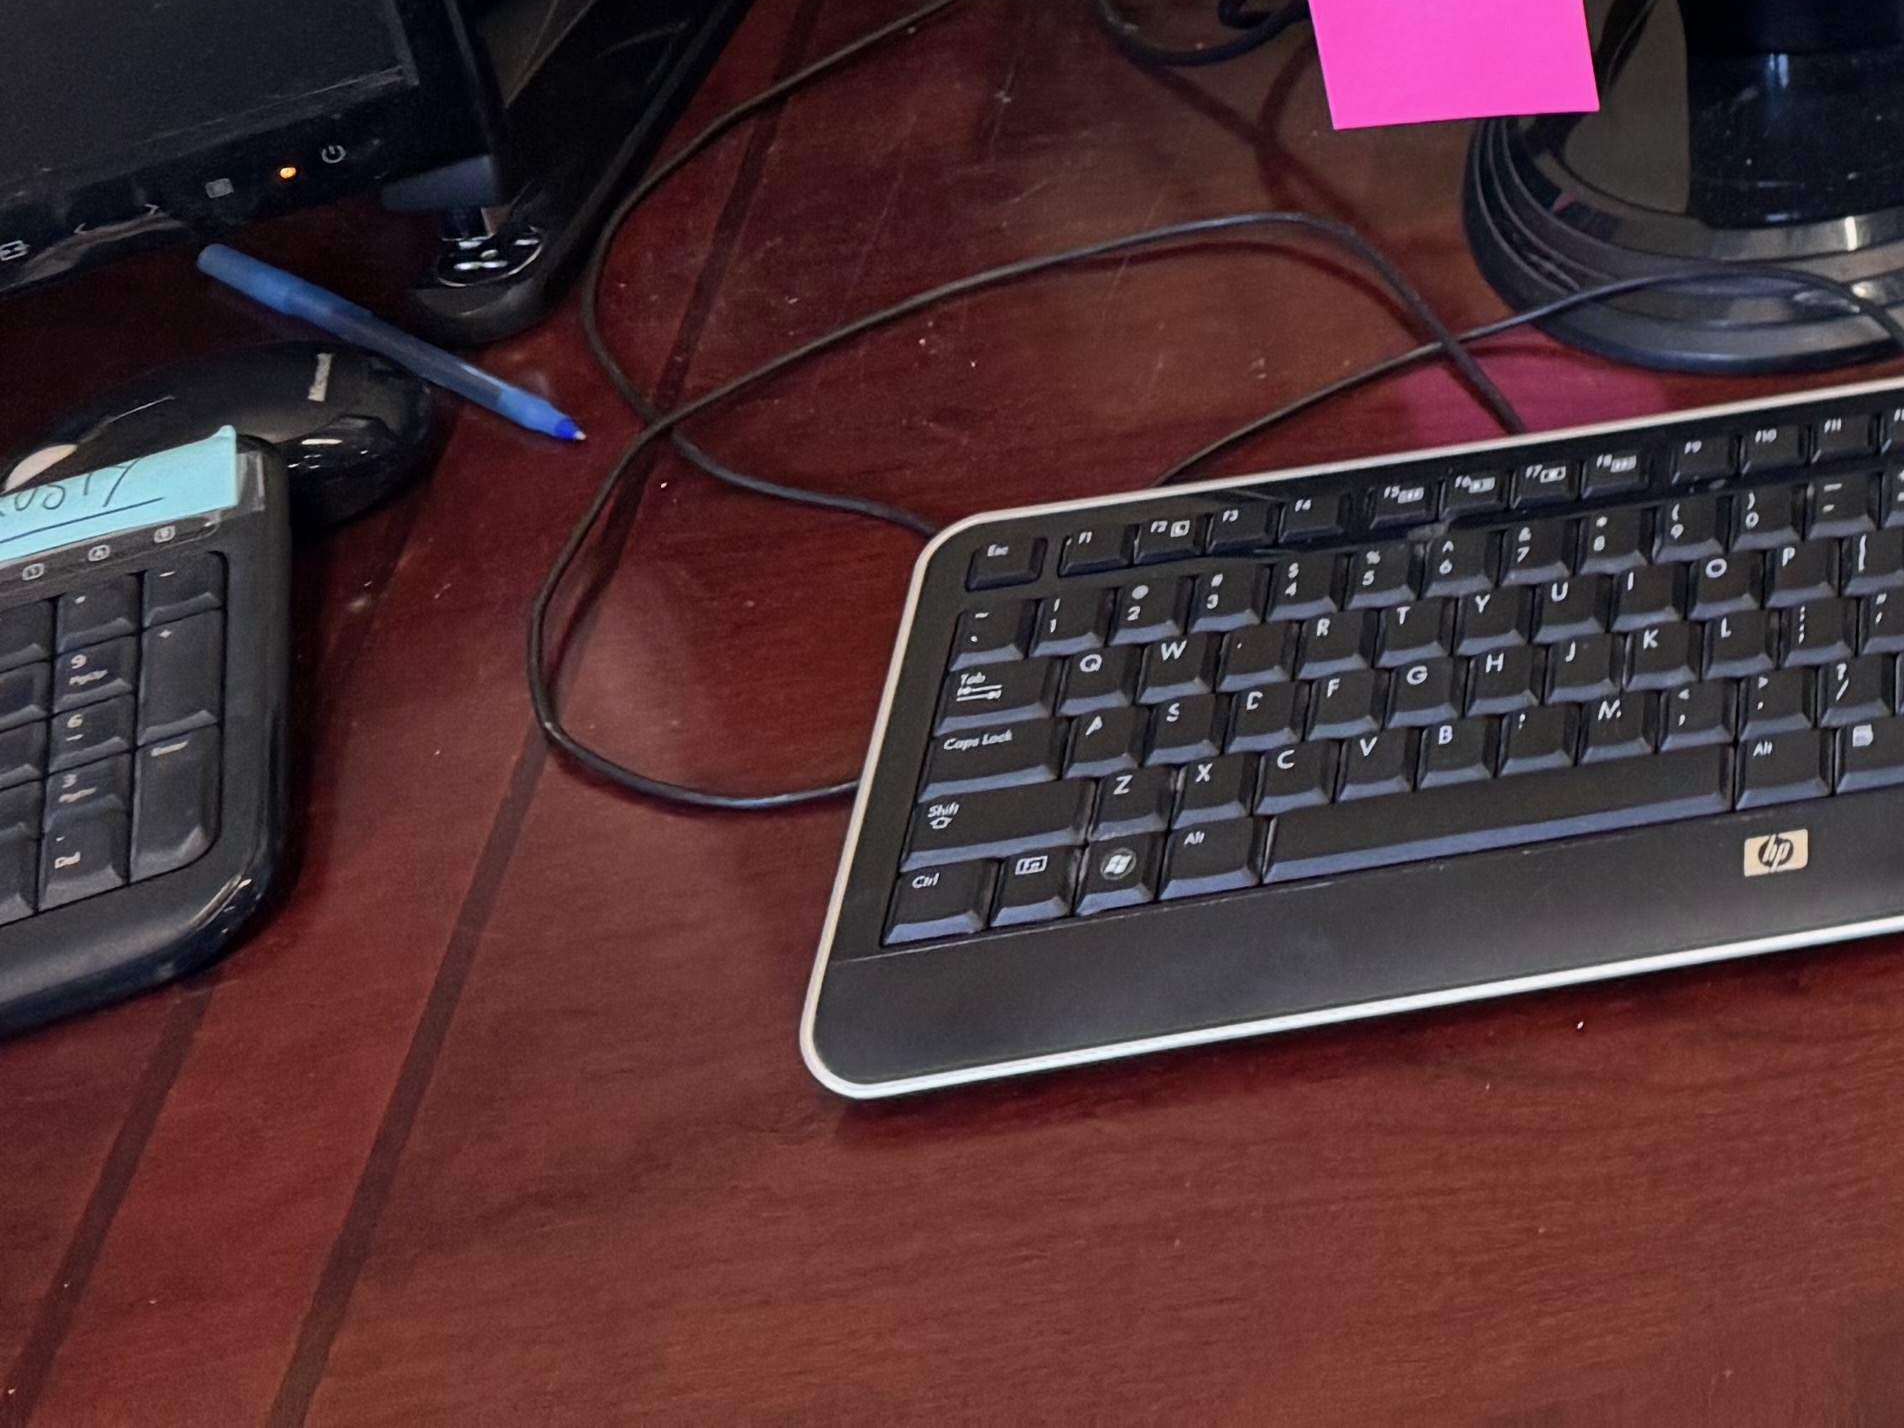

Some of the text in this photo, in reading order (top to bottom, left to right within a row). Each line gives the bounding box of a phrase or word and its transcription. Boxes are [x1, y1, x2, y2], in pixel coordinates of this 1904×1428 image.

[1294, 498, 1312, 512] F4
[1222, 509, 1239, 523] F3
[1669, 523, 1685, 540] 9
[1516, 545, 1531, 564] 7
[1781, 546, 1797, 568] P
[1438, 558, 1454, 575] 6
[1705, 556, 1728, 579] O
[1361, 569, 1376, 586] 5
[1283, 581, 1298, 597] 4
[1550, 580, 1569, 604] U
[1205, 594, 1220, 610] 3
[1473, 593, 1491, 614] Y
[1126, 605, 1142, 622] 2
[1396, 605, 1412, 626] T
[1315, 617, 1331, 637] R
[1720, 616, 1733, 639] L
[1641, 627, 1660, 650] K
[1160, 639, 1188, 662] W
[1563, 640, 1577, 664] J
[70, 653, 88, 670] 9
[1079, 652, 1103, 674] Q
[1484, 651, 1506, 674] H
[959, 670, 987, 686] Tab
[1405, 664, 1429, 686] G
[1326, 677, 1342, 699] F
[66, 713, 84, 729] 6
[1164, 701, 1181, 723] S
[1084, 715, 1103, 736] A
[1437, 724, 1455, 746] B
[943, 729, 1014, 752] Caps Lock
[1358, 735, 1379, 758] V
[1752, 741, 1773, 757] Alt
[1275, 749, 1297, 770] C
[1193, 762, 1214, 784] X
[1112, 774, 1134, 795] Z
[926, 800, 961, 818] Shift
[1183, 830, 1206, 846] Alt
[911, 871, 941, 890] Ctrl
